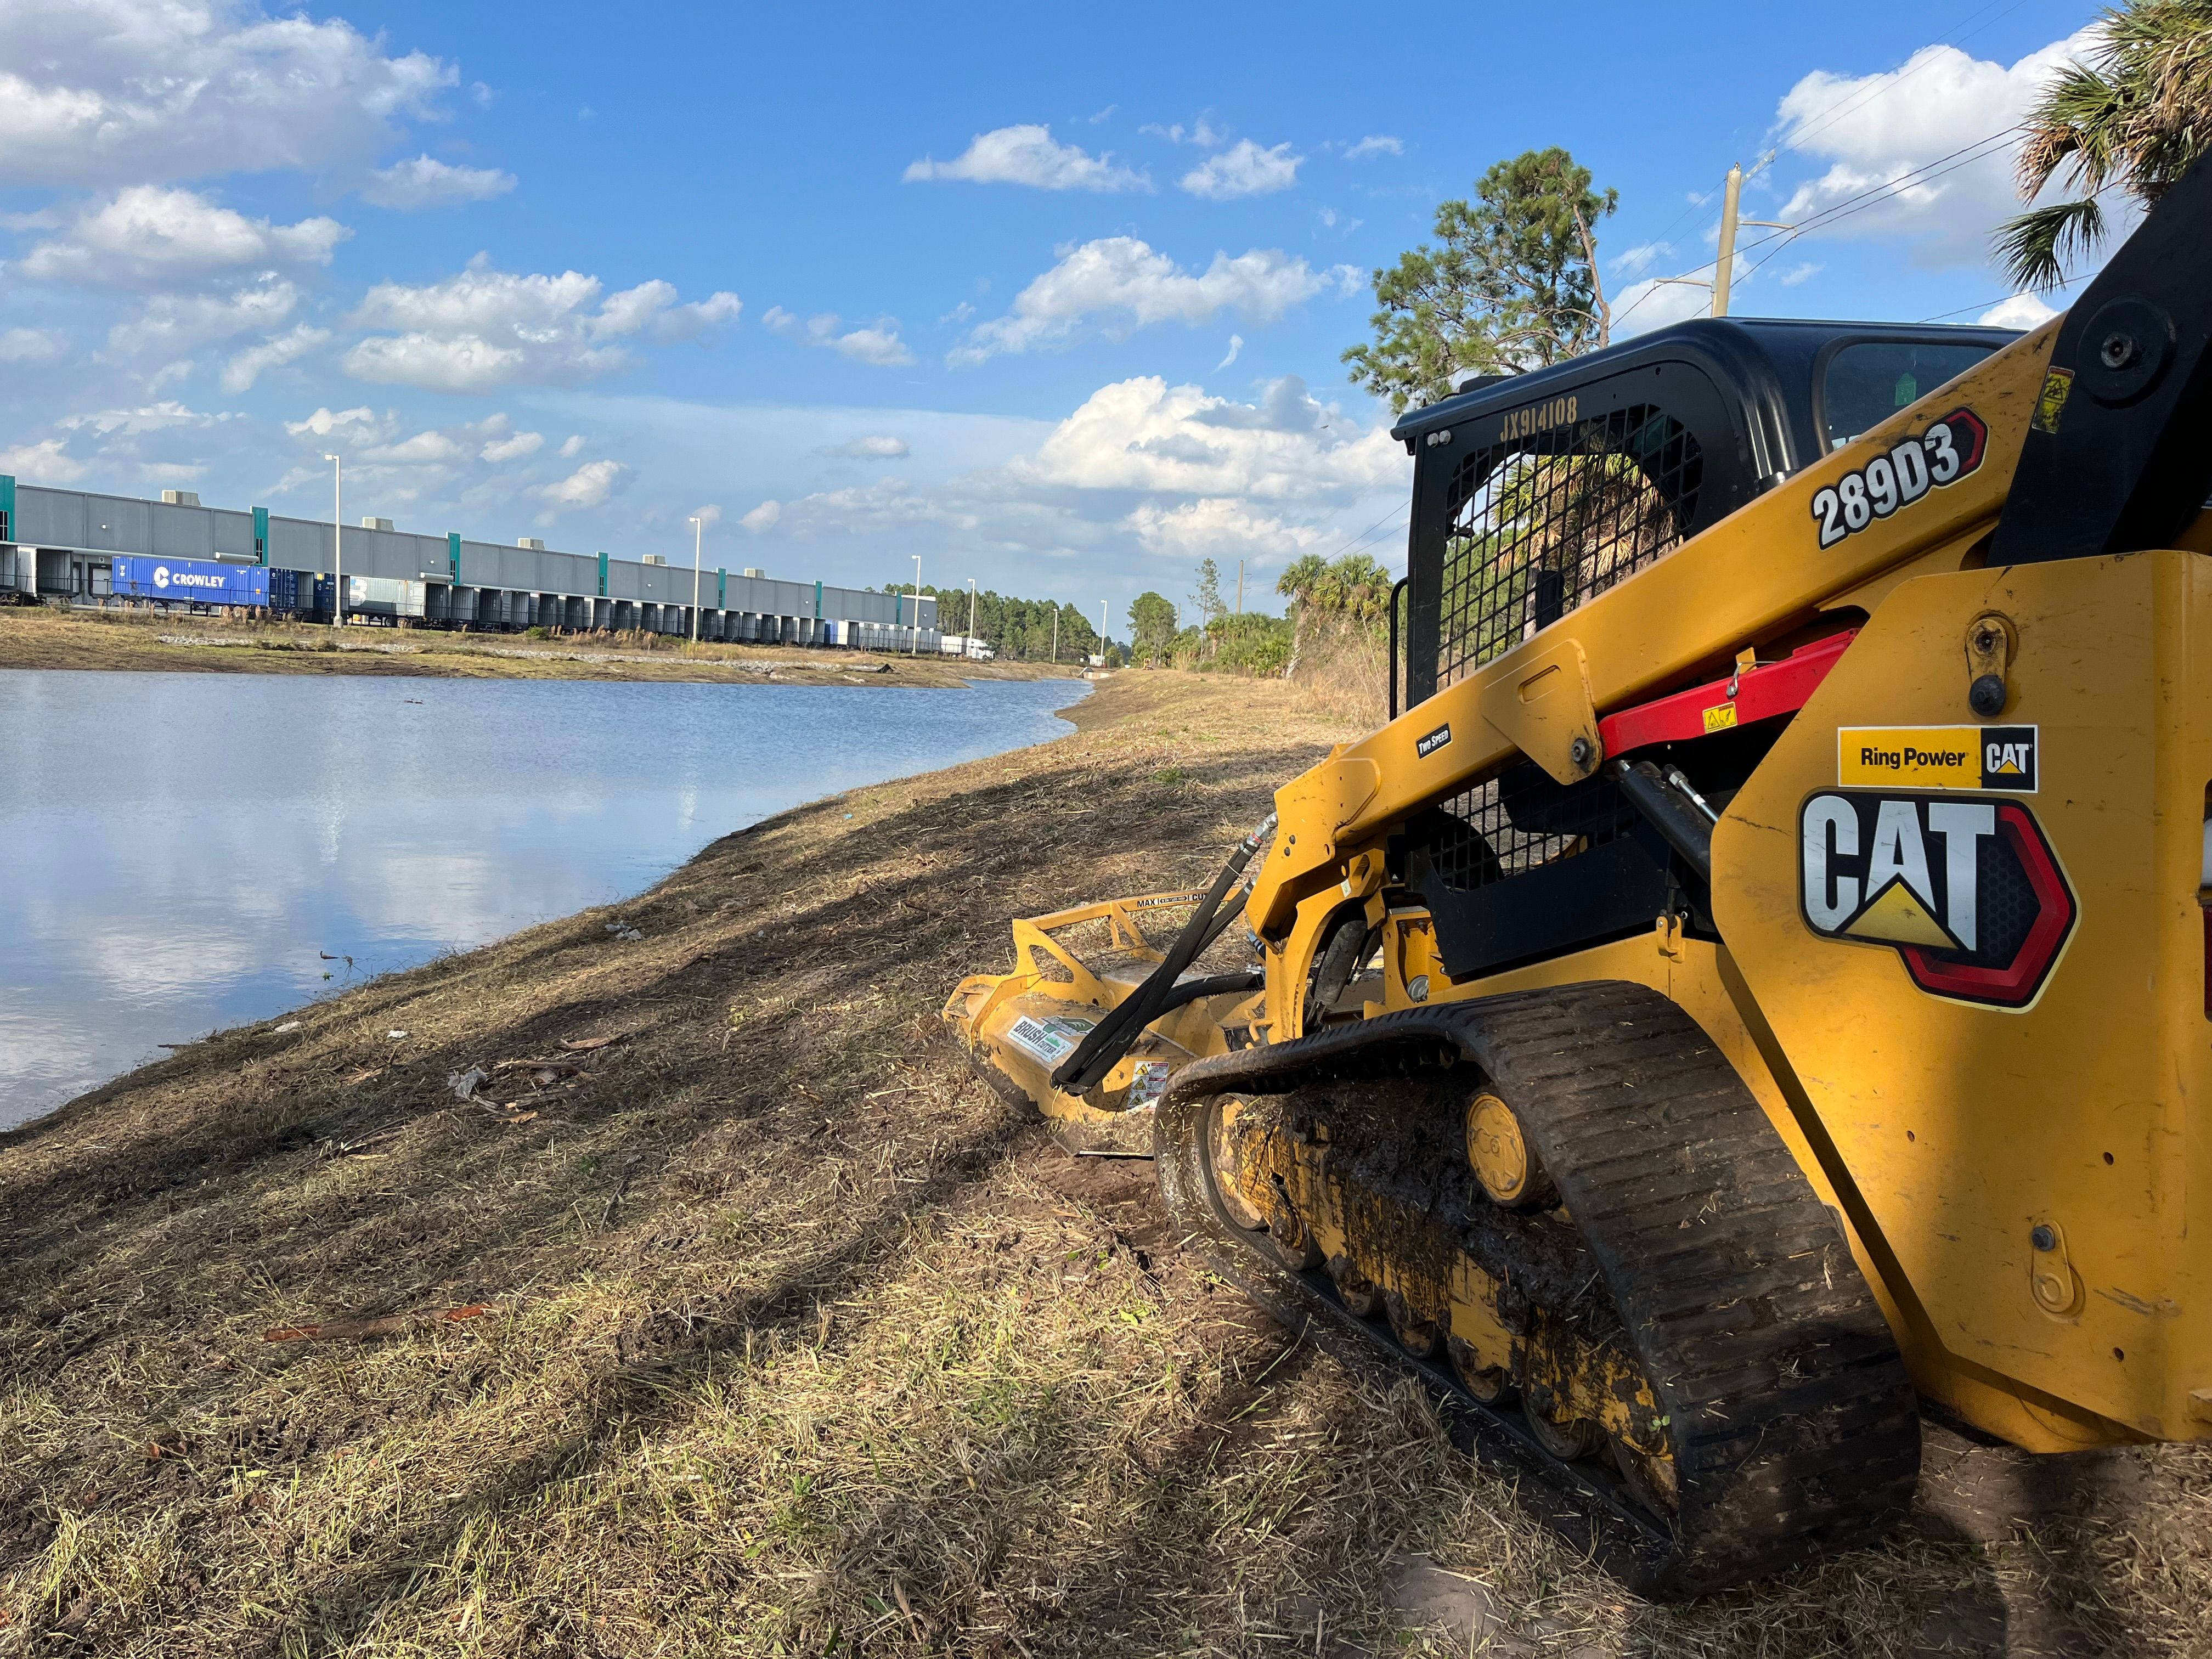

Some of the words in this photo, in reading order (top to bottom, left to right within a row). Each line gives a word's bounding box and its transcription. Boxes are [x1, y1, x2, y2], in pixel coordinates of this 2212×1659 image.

[1500, 396, 1577, 442] JX914108
[1813, 423, 1960, 546] 289D3
[173, 573, 224, 588] CROWLEY
[1861, 747, 1900, 769] Ring
[1904, 748, 1966, 766] Power
[1986, 743, 2029, 774] CAT
[1803, 795, 1995, 951] CAT
[1137, 899, 1155, 908] MAX
[1013, 1020, 1048, 1045] BRUSH
[1037, 1040, 1057, 1054] CUTTER
